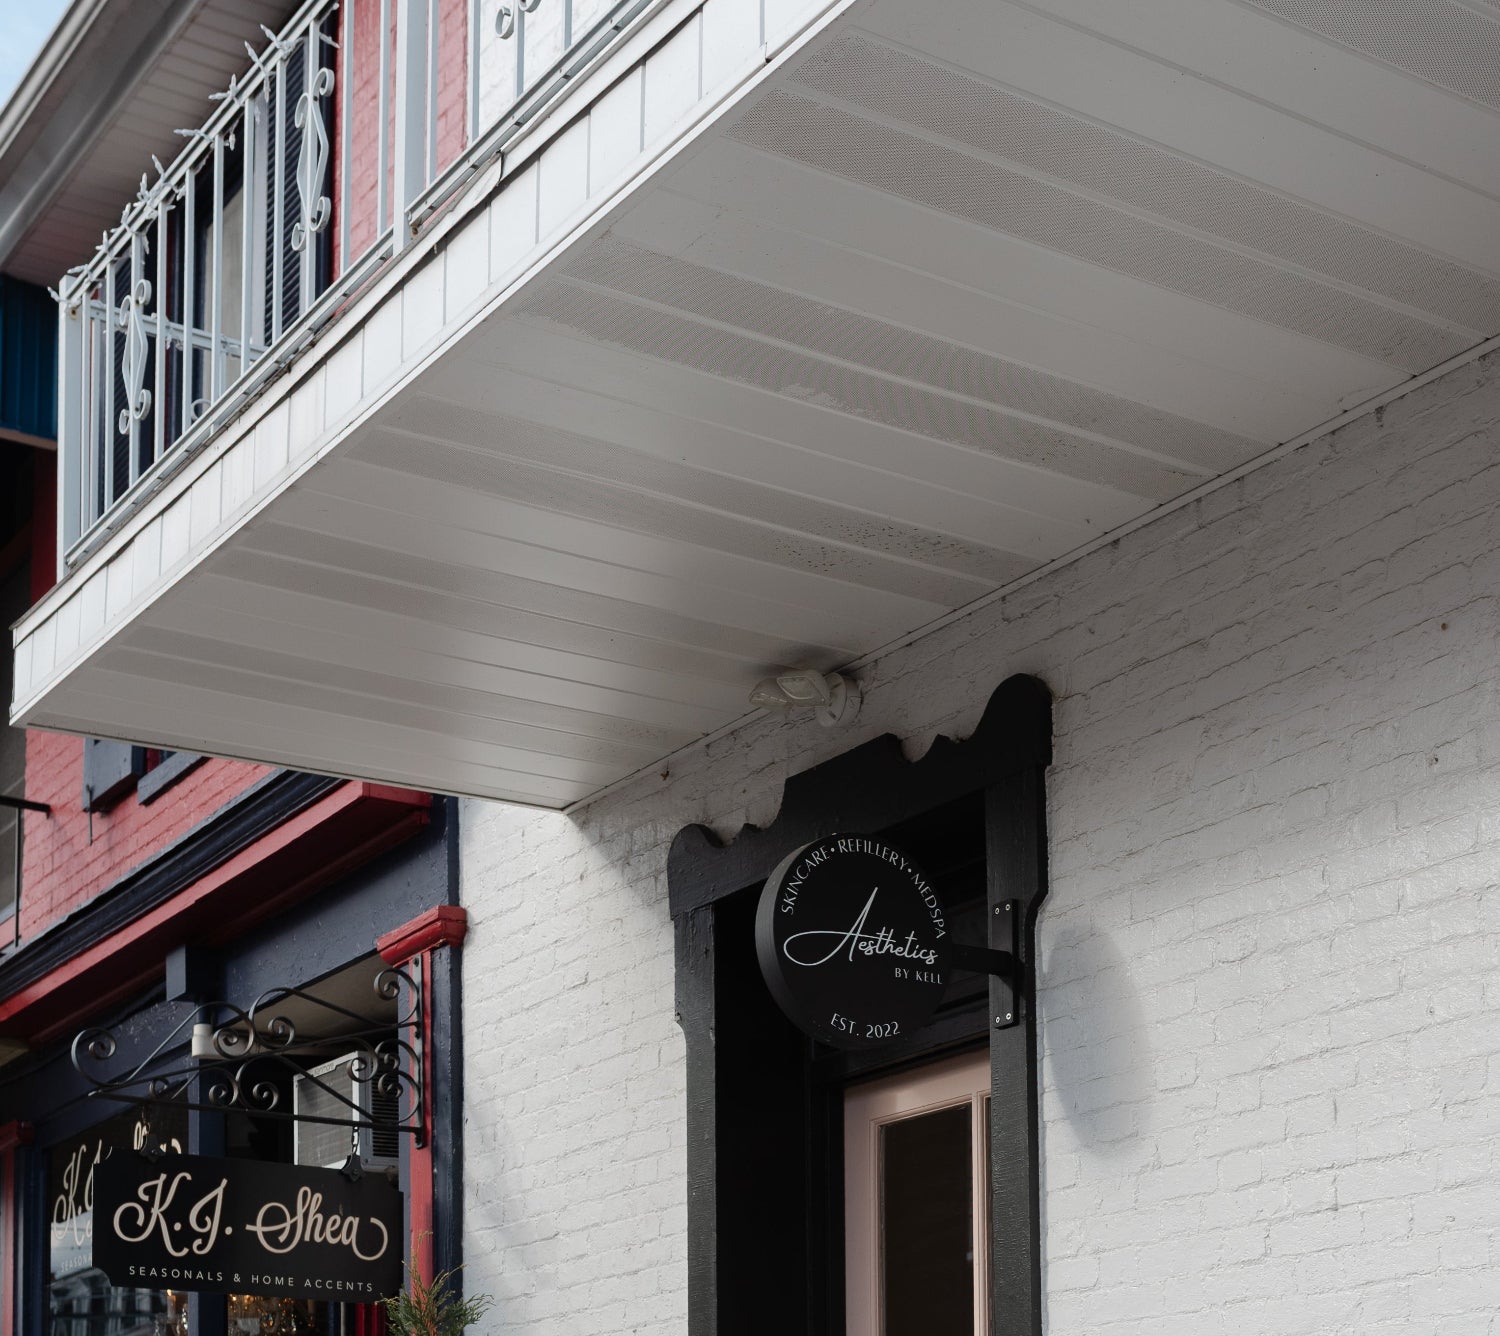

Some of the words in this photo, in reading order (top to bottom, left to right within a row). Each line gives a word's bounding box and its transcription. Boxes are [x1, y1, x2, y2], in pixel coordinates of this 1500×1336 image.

[780, 844, 831, 915] SKINCARE
[837, 838, 908, 871] REFILLERY
[909, 872, 946, 940] MEDSPA
[782, 886, 939, 966] Aesthetics
[895, 967, 909, 979] BY
[915, 969, 943, 985] KELL
[830, 1012, 860, 1037] EST.
[865, 1021, 901, 1039] 2022
[245, 1185, 389, 1261] Shea
[61, 1255, 92, 1272] SEASONA
[129, 1265, 224, 1286] SEASONALS
[233, 1273, 242, 1284] &
[251, 1275, 295, 1288] HOME
[304, 1278, 374, 1293] ACCENTS
